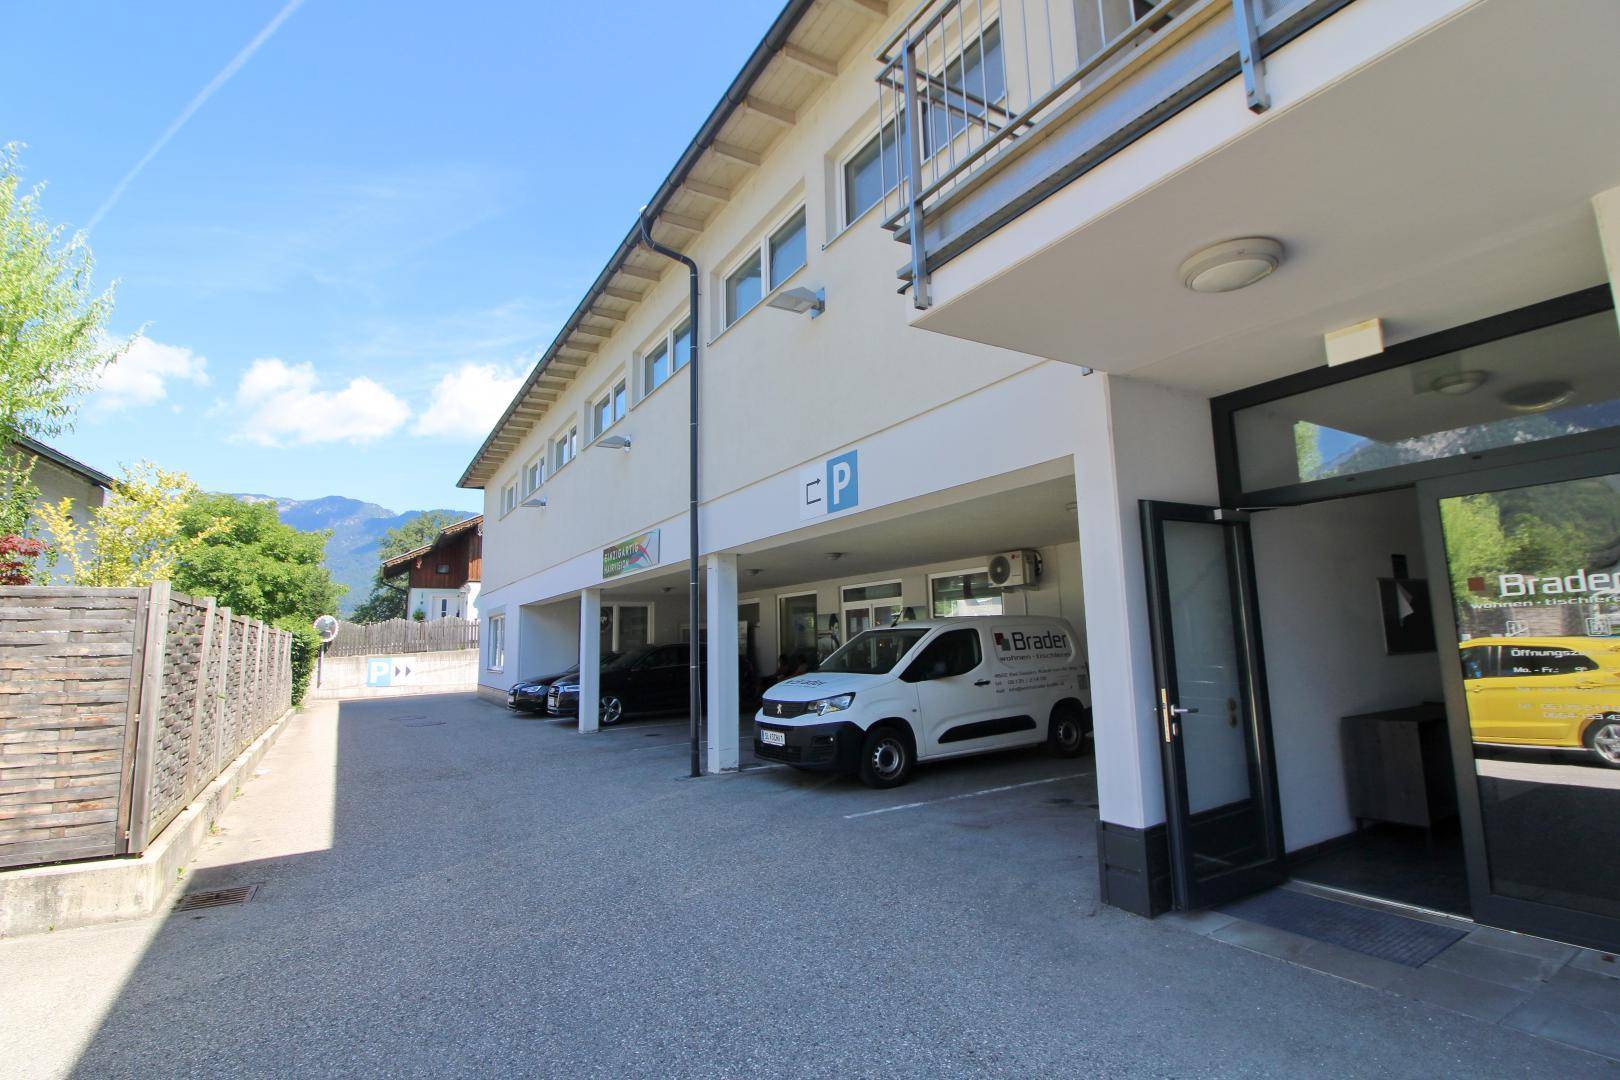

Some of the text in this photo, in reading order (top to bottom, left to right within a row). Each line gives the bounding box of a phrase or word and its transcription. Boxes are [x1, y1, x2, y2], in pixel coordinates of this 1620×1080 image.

[833, 462, 850, 504] P
[1011, 630, 1068, 651] Brader
[370, 662, 389, 683] P
